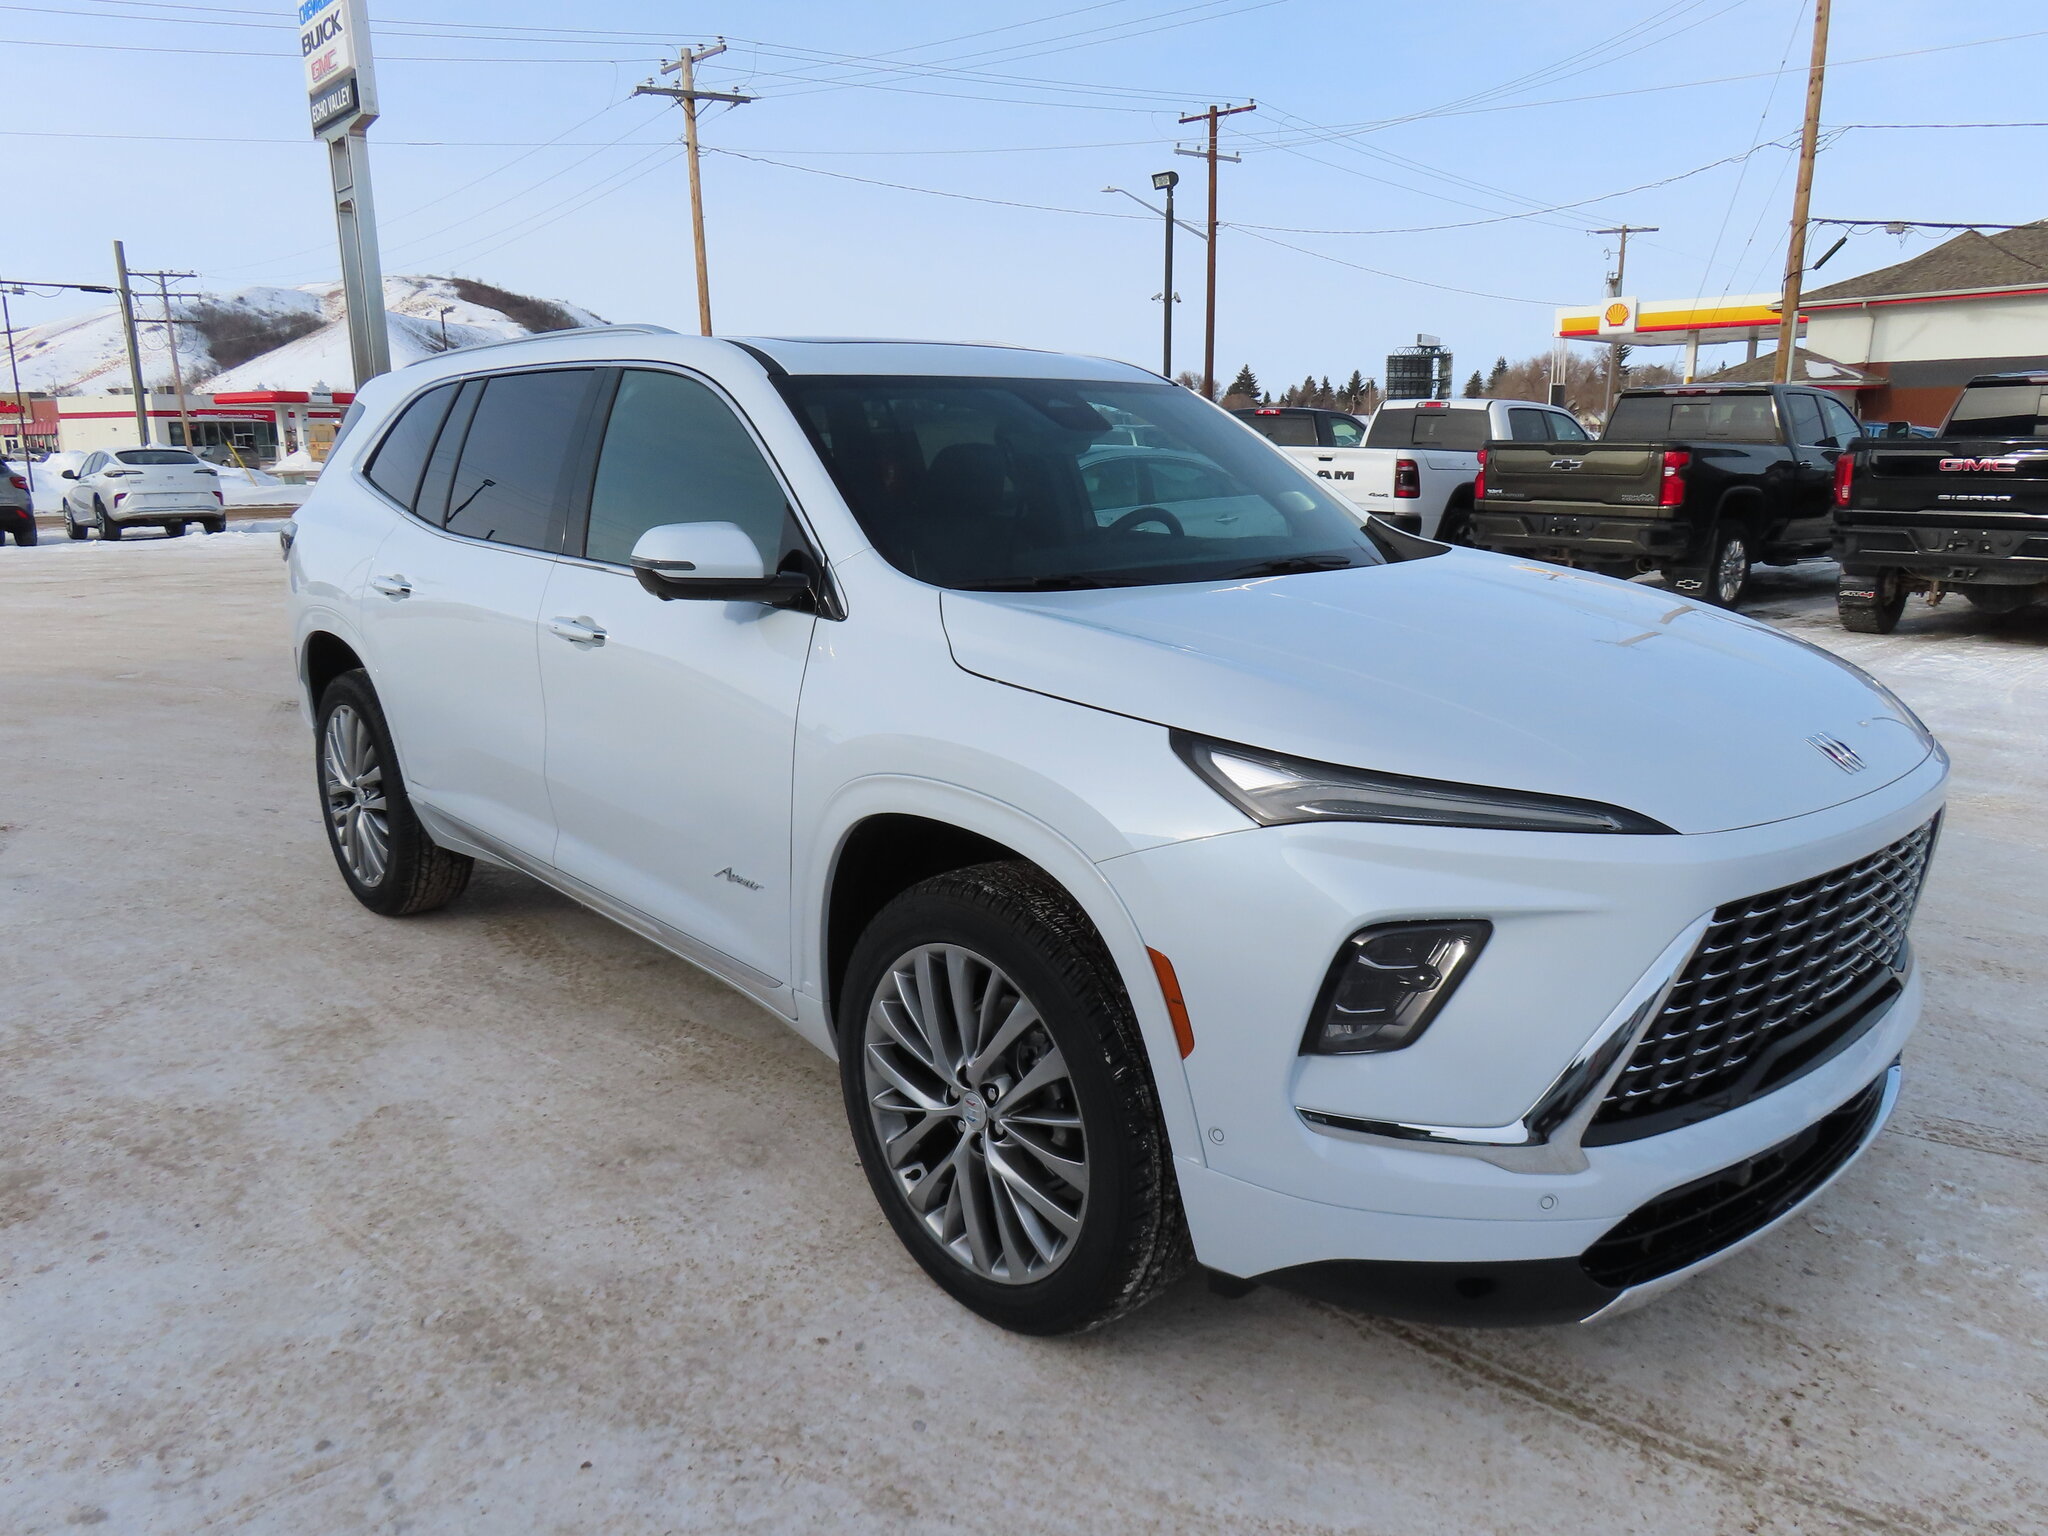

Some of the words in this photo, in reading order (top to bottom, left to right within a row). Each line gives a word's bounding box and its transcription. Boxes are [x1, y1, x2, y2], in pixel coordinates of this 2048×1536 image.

[301, 9, 343, 57] BUICK
[311, 49, 337, 81] GMC
[327, 85, 350, 115] VALLEY
[1939, 458, 2019, 472] GMC
[1317, 470, 1355, 481] AM
[1938, 494, 2012, 502] SIERRA
[1839, 590, 1875, 599] AT4
